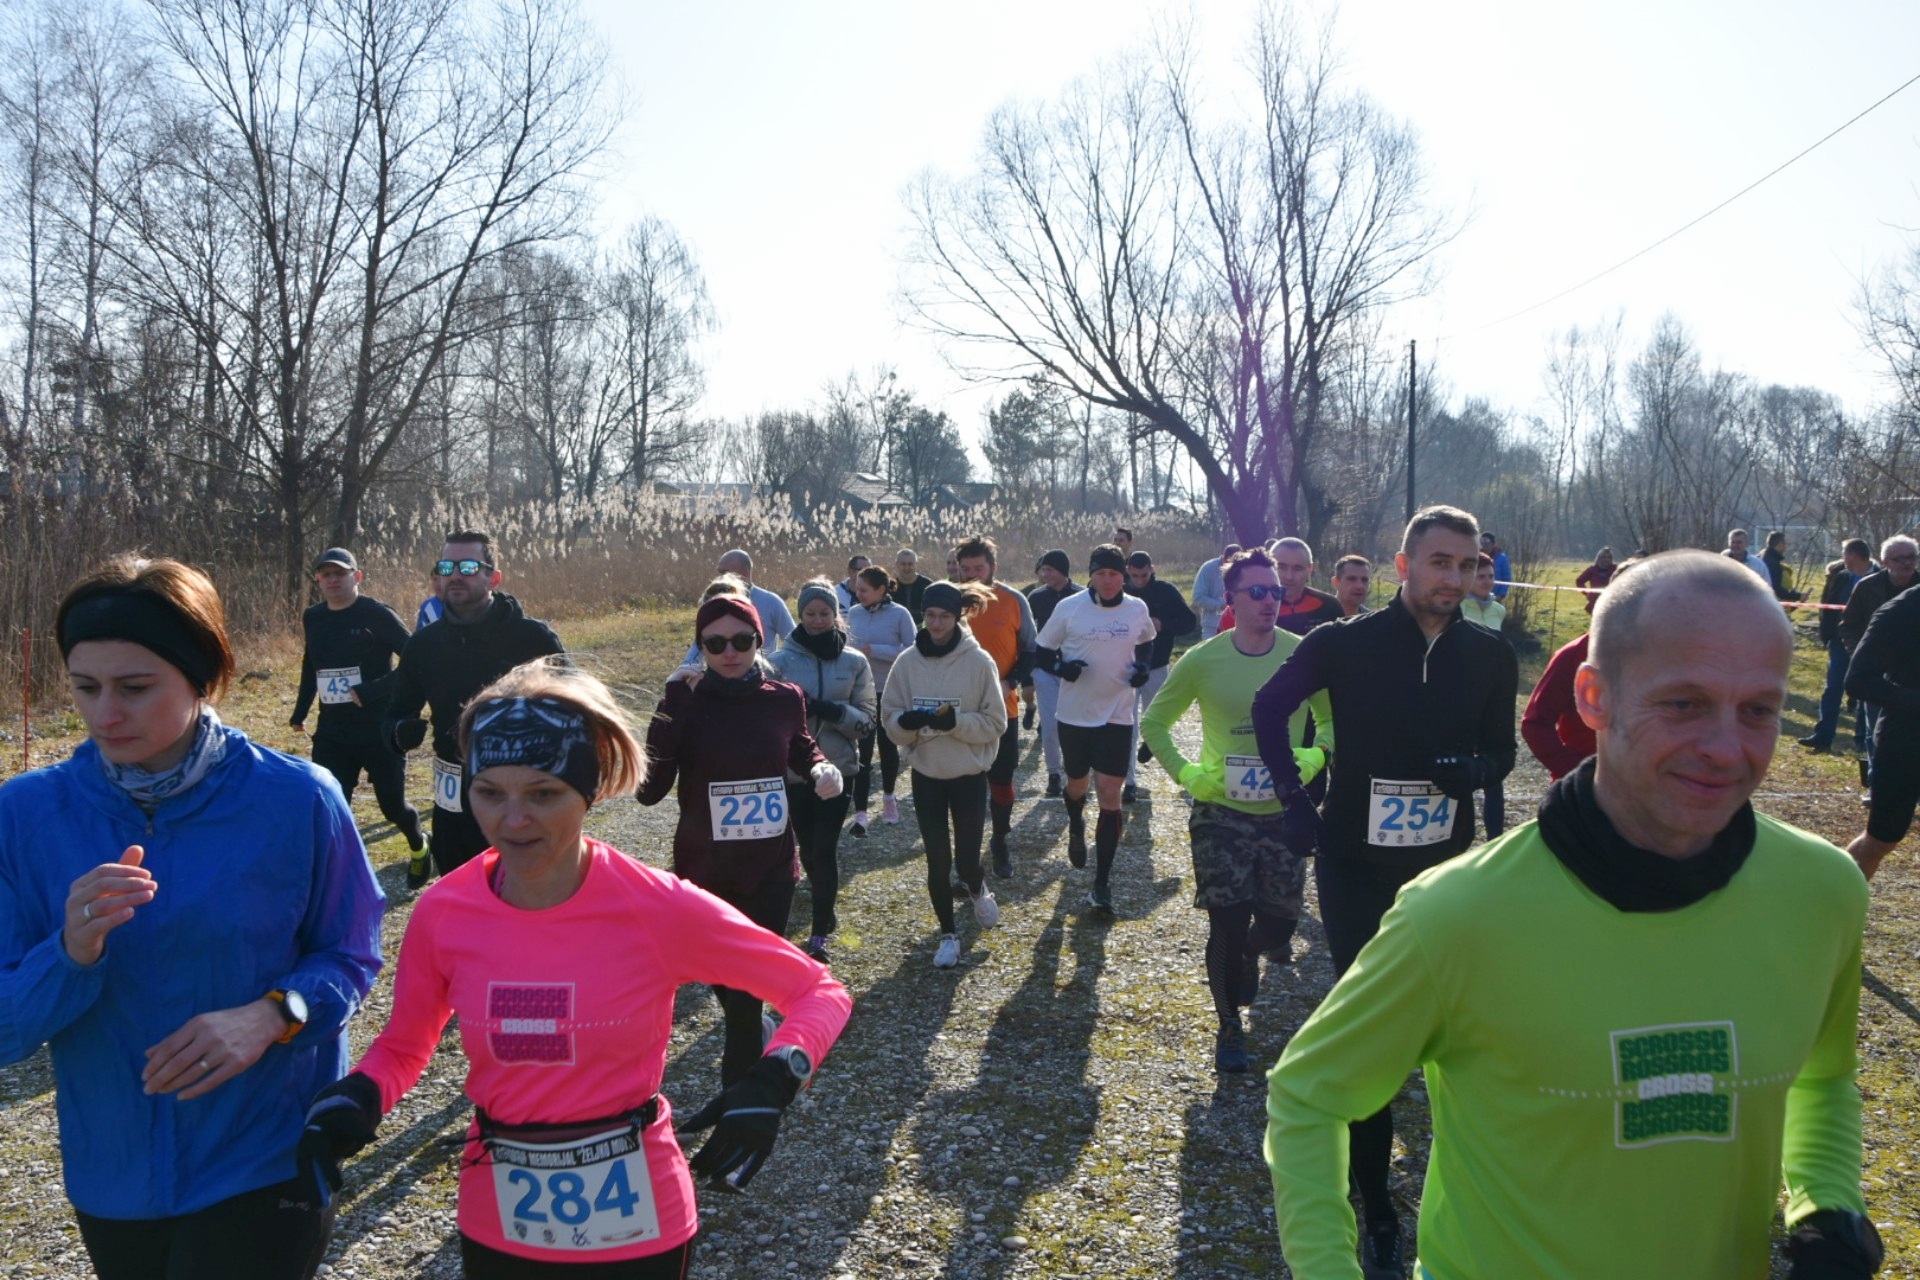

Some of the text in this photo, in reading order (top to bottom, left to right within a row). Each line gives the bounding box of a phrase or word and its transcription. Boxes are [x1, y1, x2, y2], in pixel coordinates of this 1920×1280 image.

[327, 677, 350, 695] 43
[436, 771, 457, 800] 70
[1241, 768, 1275, 790] 42
[719, 793, 783, 826] 226
[1379, 796, 1450, 831] 254
[501, 1018, 557, 1035] CROSS
[1618, 1029, 1728, 1060] SCROSSC
[1620, 1051, 1729, 1082] ROSSROS
[1637, 1073, 1714, 1100] CROSS
[508, 1158, 640, 1225] 284
